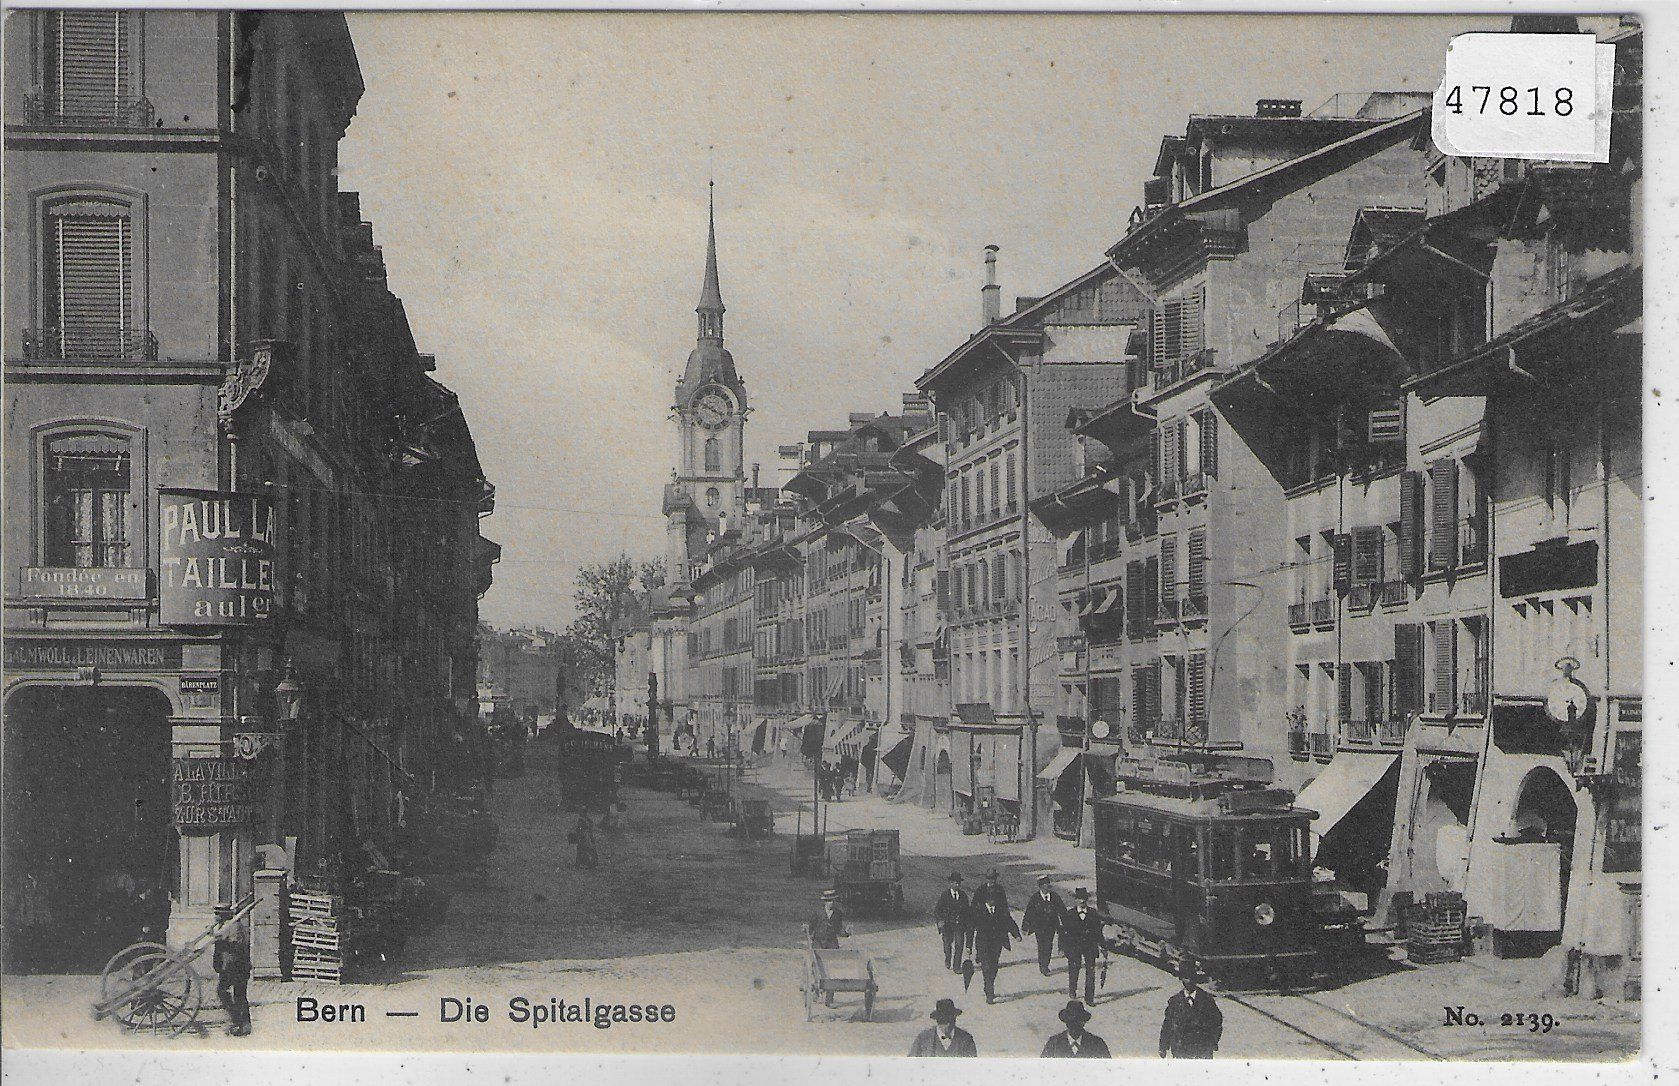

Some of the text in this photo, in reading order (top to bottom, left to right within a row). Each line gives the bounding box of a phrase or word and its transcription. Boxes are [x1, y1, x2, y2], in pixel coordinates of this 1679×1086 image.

[1445, 85, 1574, 117] 47818
[163, 498, 277, 550] PAUL LA
[58, 583, 107, 596] 1840
[162, 557, 276, 592] TAILLE
